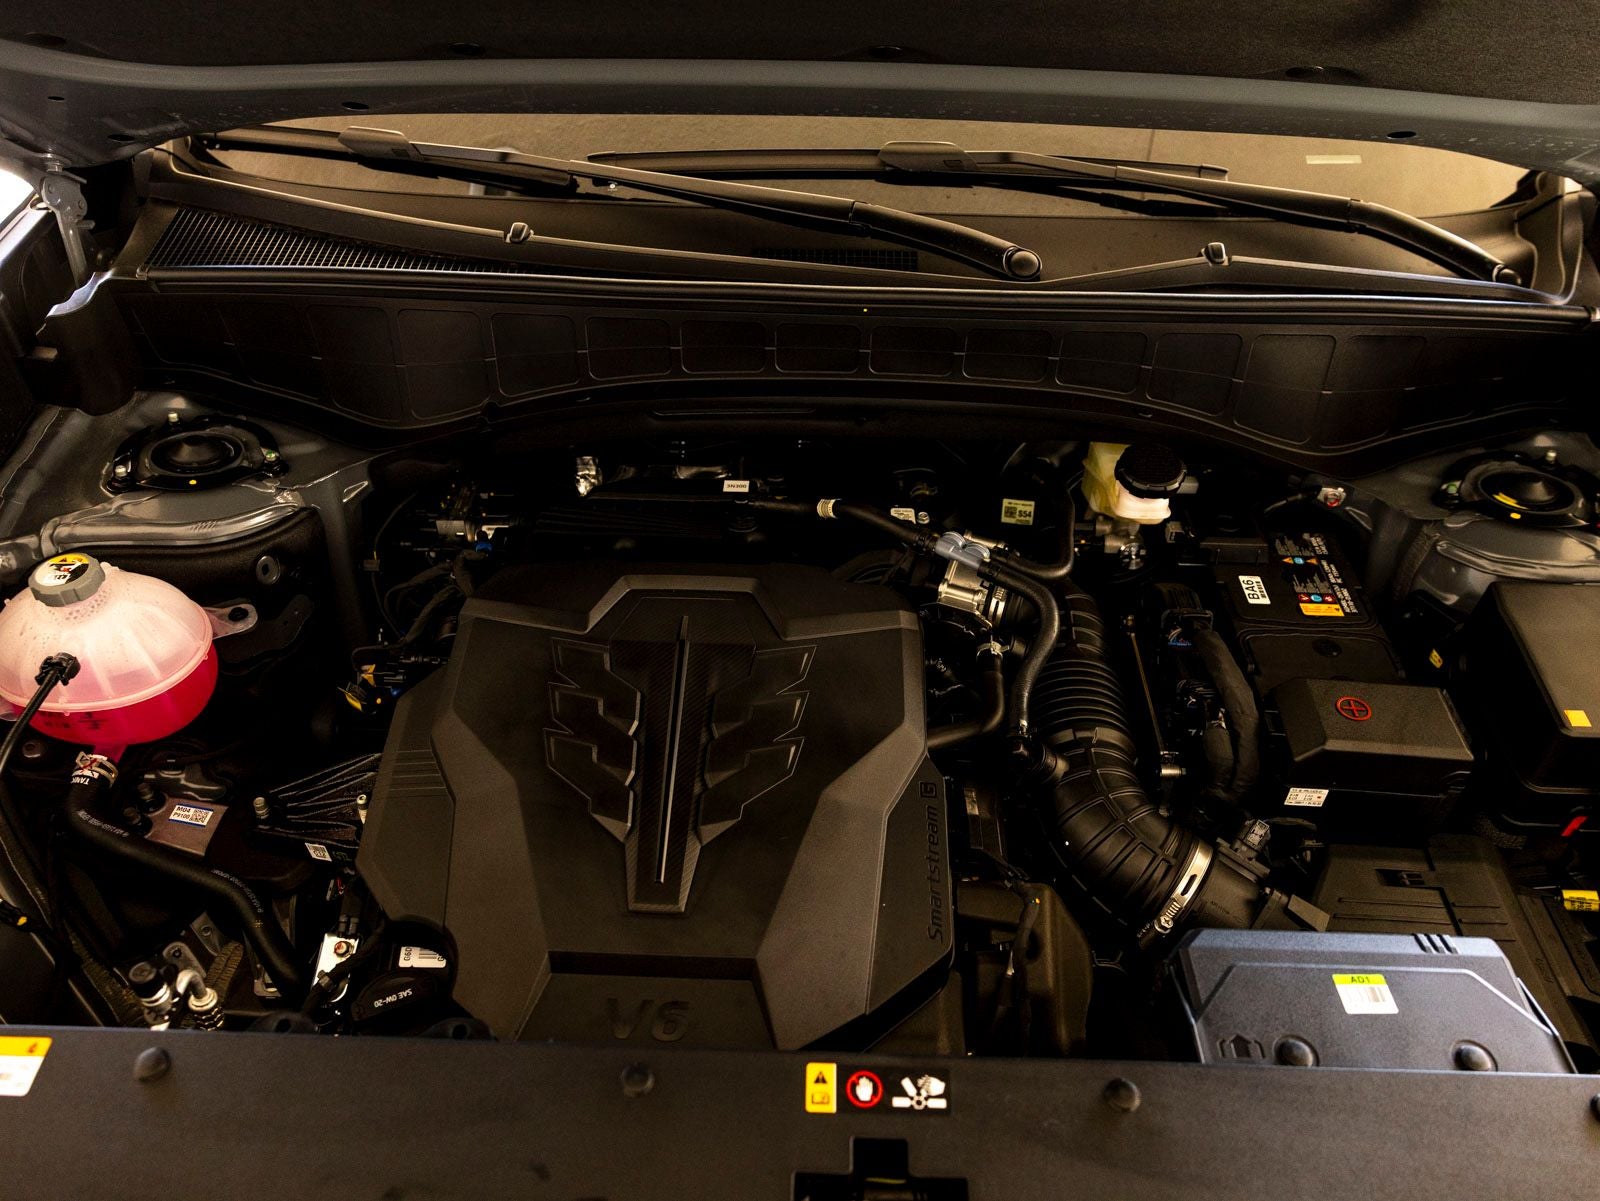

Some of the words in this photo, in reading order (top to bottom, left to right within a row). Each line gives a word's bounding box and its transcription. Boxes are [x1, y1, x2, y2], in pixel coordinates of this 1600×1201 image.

[1243, 579, 1260, 600] BA6
[71, 776, 90, 786] TANK
[925, 805, 943, 944] Smartstream
[373, 994, 397, 1008] 0W-20
[398, 988, 413, 999] SAE
[606, 997, 690, 1042] V6
